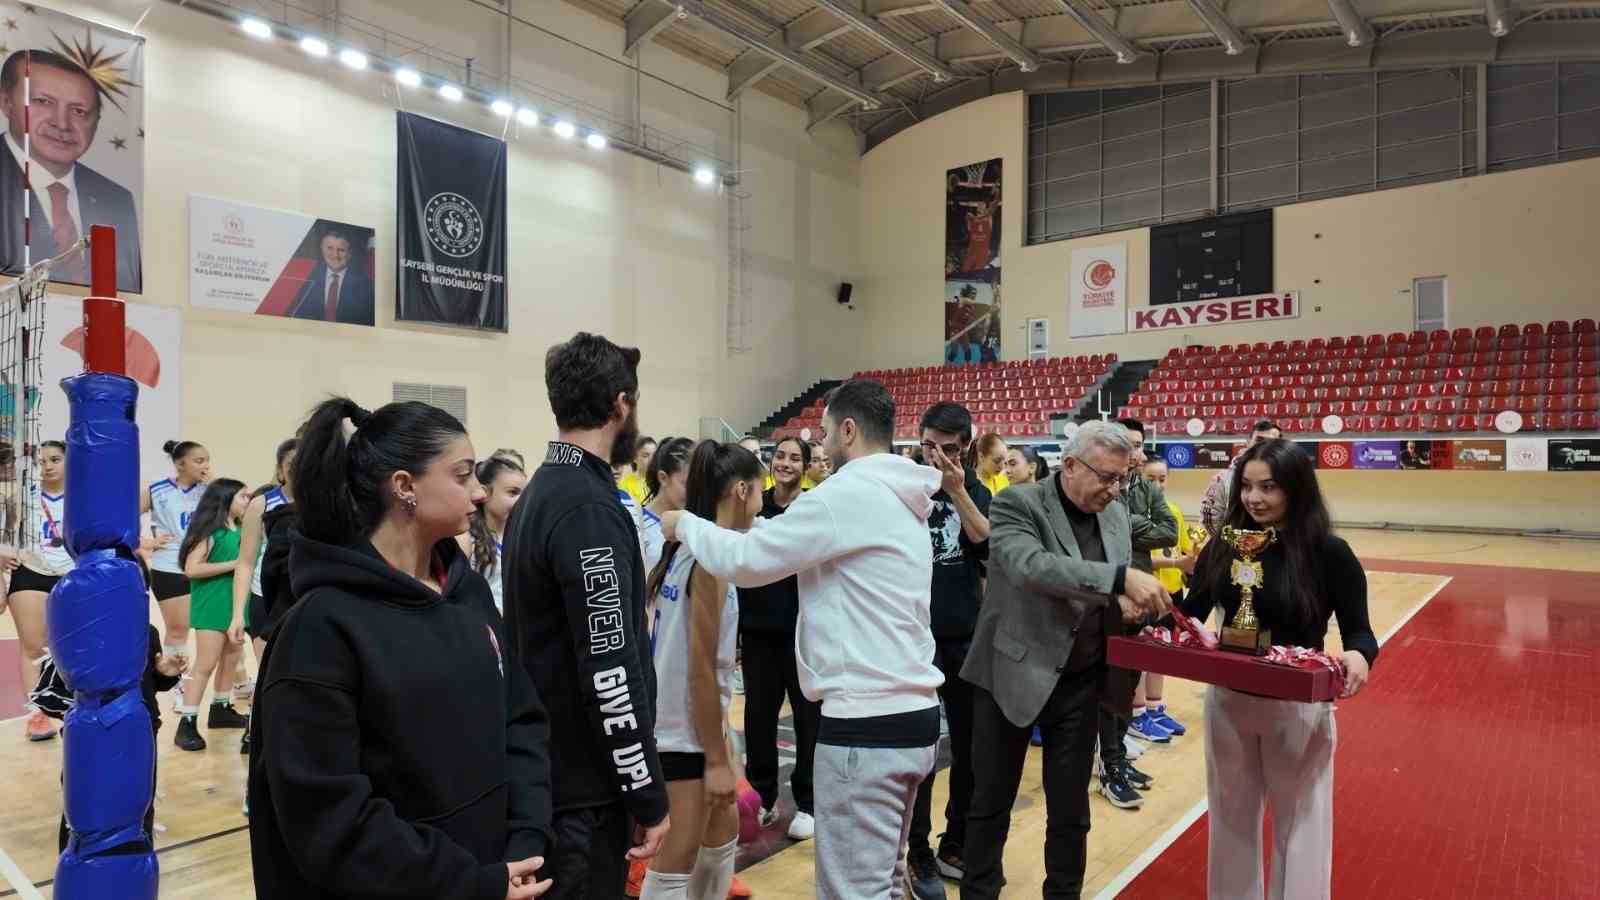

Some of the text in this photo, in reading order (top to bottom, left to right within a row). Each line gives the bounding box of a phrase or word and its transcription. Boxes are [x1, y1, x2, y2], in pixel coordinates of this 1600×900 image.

[1135, 293, 1293, 330] KAYSERİ
[579, 546, 654, 792] NEVER GIVE UP!
